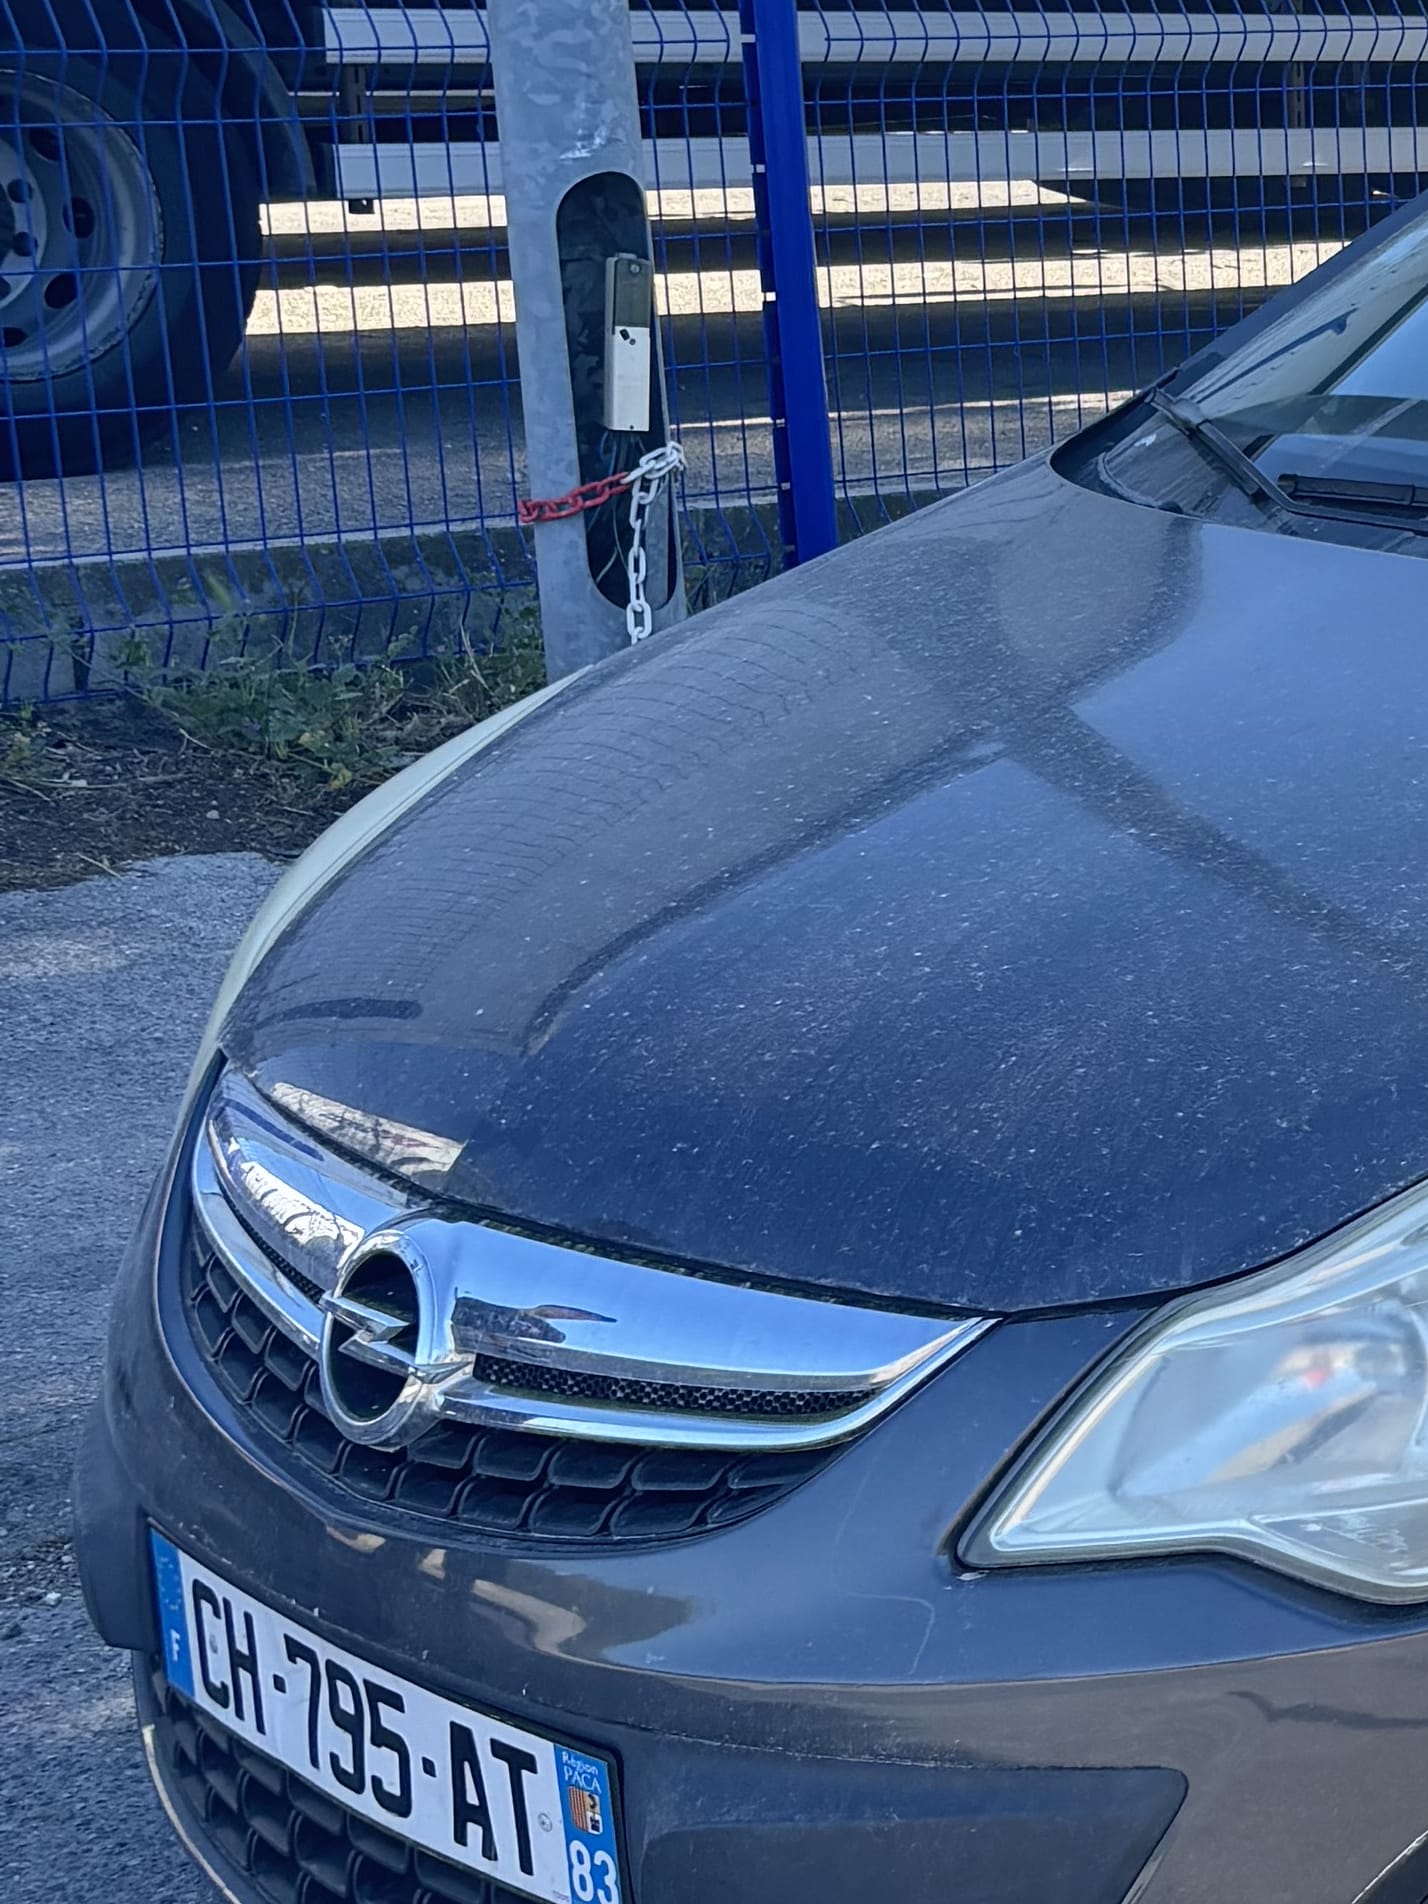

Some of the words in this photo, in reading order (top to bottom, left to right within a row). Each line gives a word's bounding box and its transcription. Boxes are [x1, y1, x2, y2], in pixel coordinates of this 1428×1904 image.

[170, 1628, 181, 1663] F
[192, 1578, 539, 1877] CH-795-AT
[563, 1765, 603, 1795] PACA
